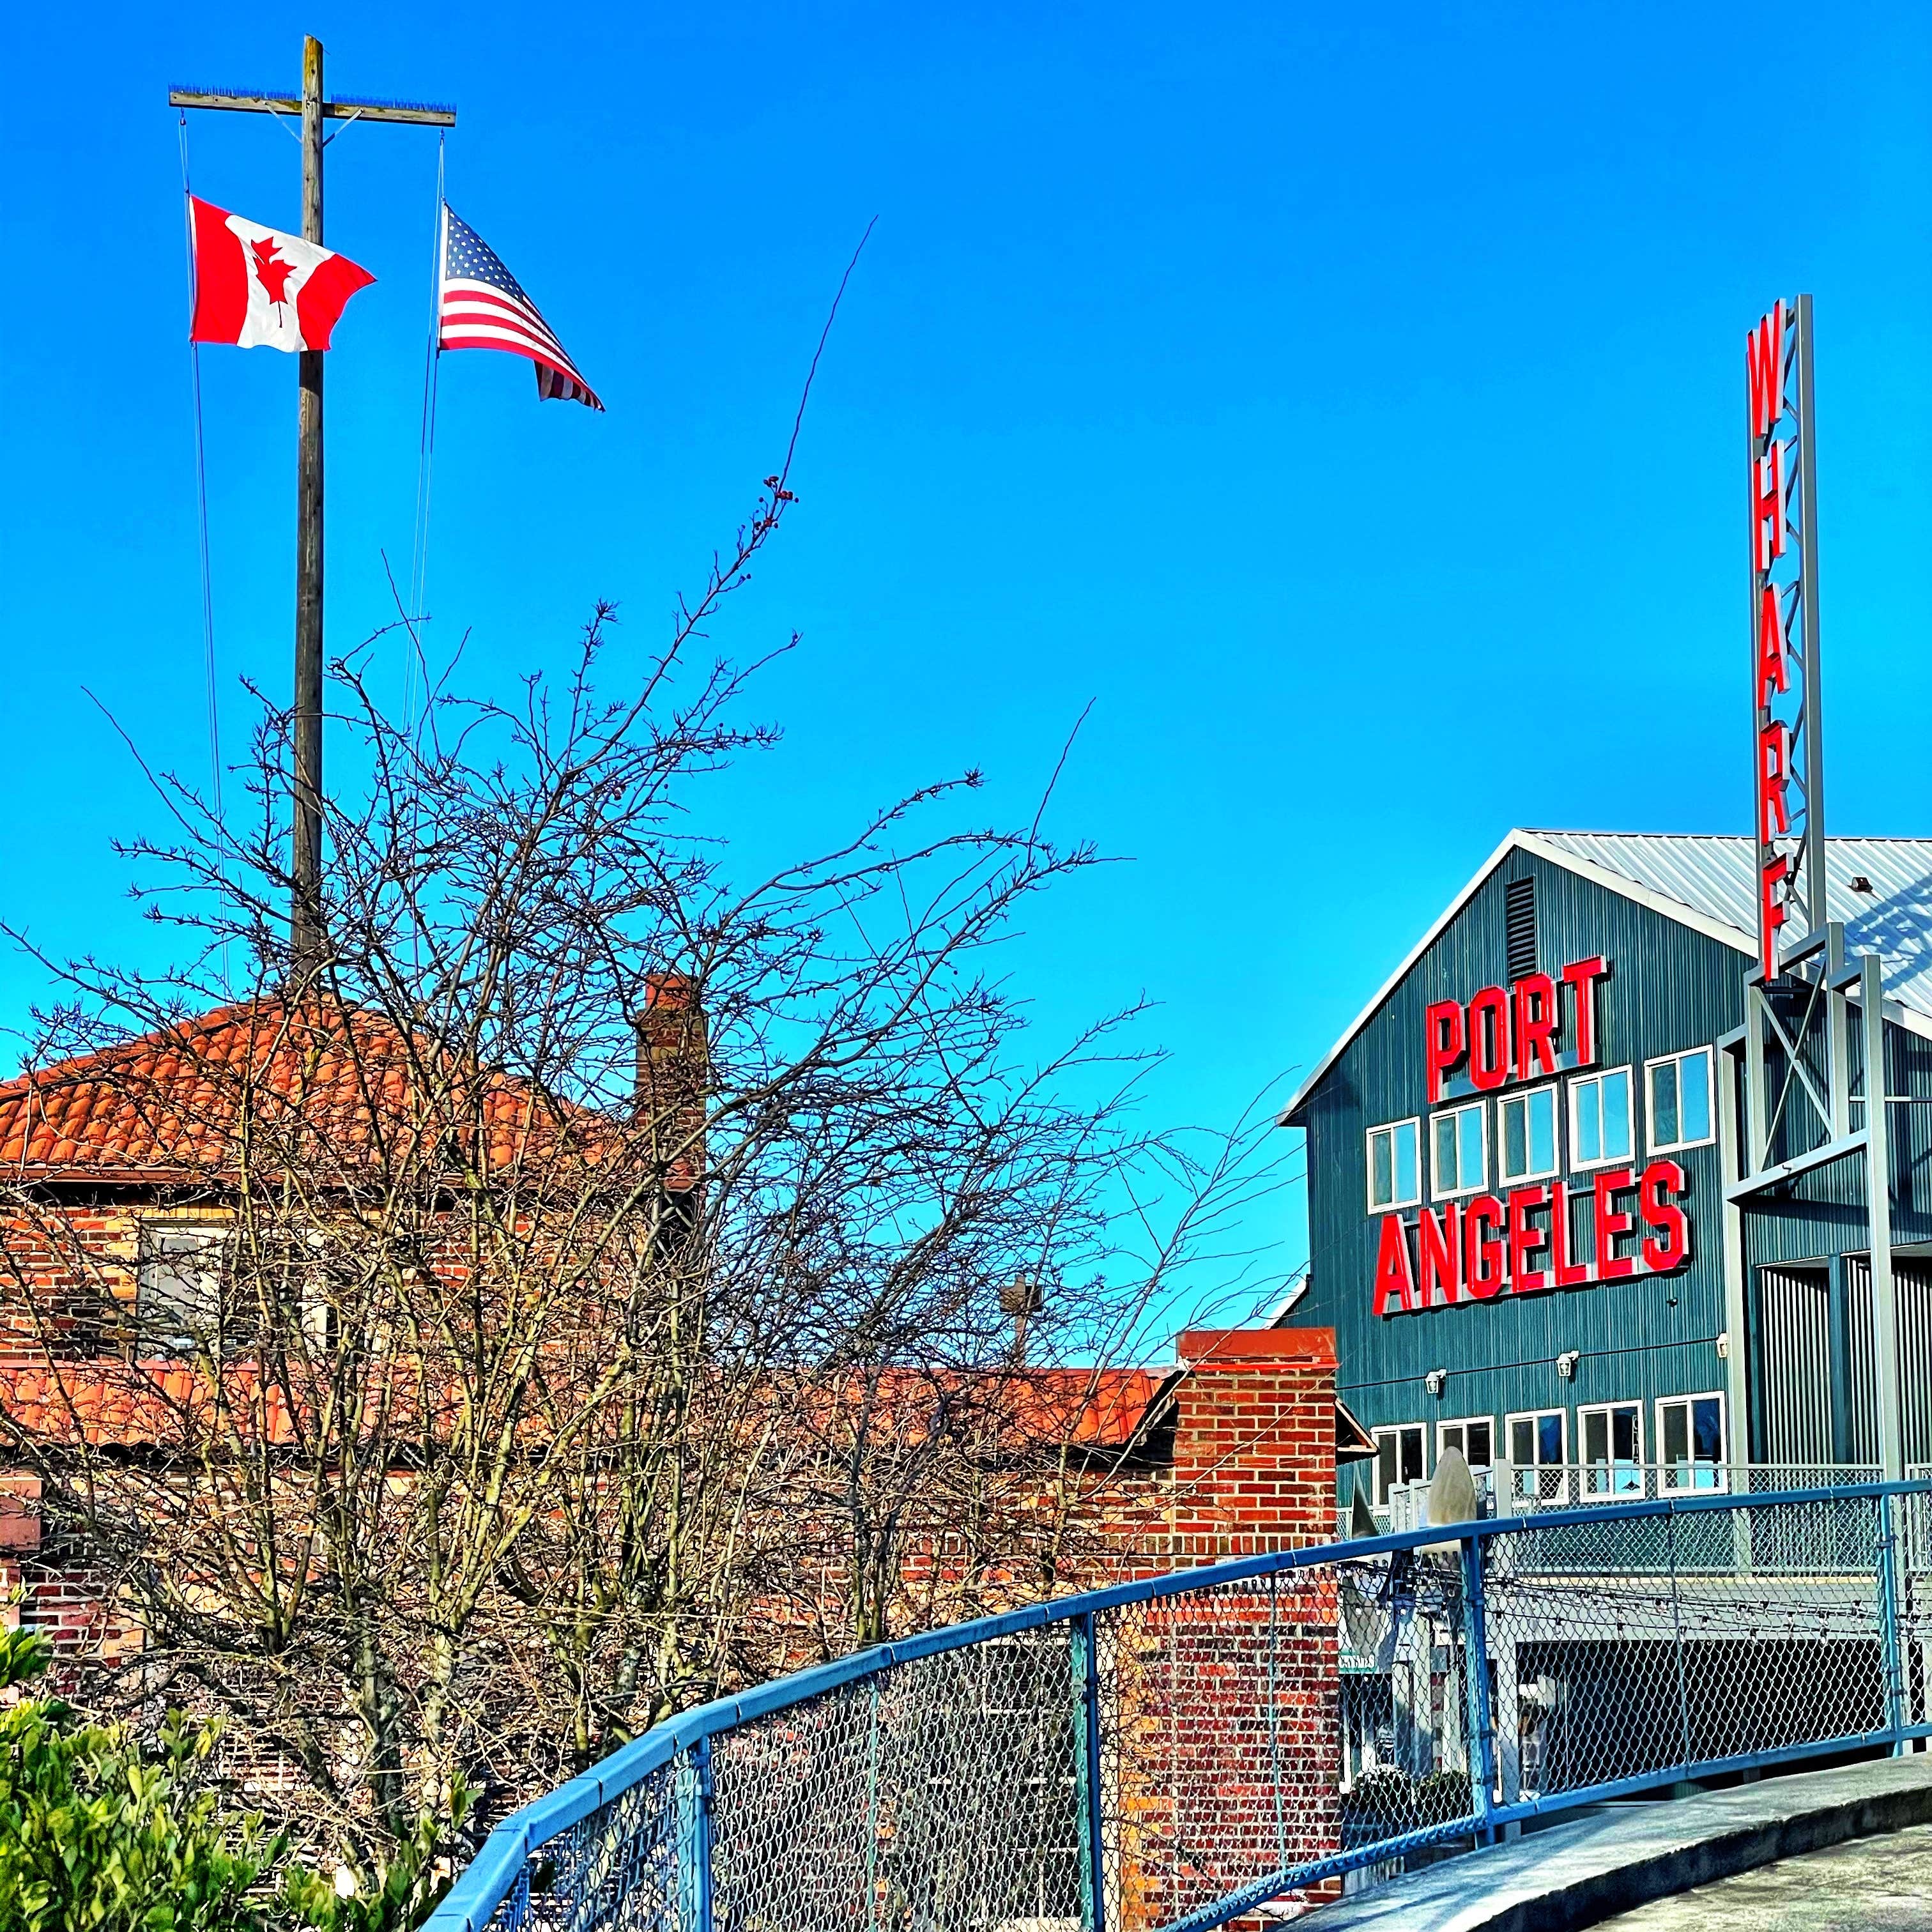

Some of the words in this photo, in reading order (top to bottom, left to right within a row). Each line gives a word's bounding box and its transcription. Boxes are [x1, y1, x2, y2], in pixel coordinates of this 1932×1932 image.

[1747, 298, 1793, 983] WHARF
[1425, 955, 1606, 1104] PORT
[1372, 1160, 1688, 1315] ANGELES
